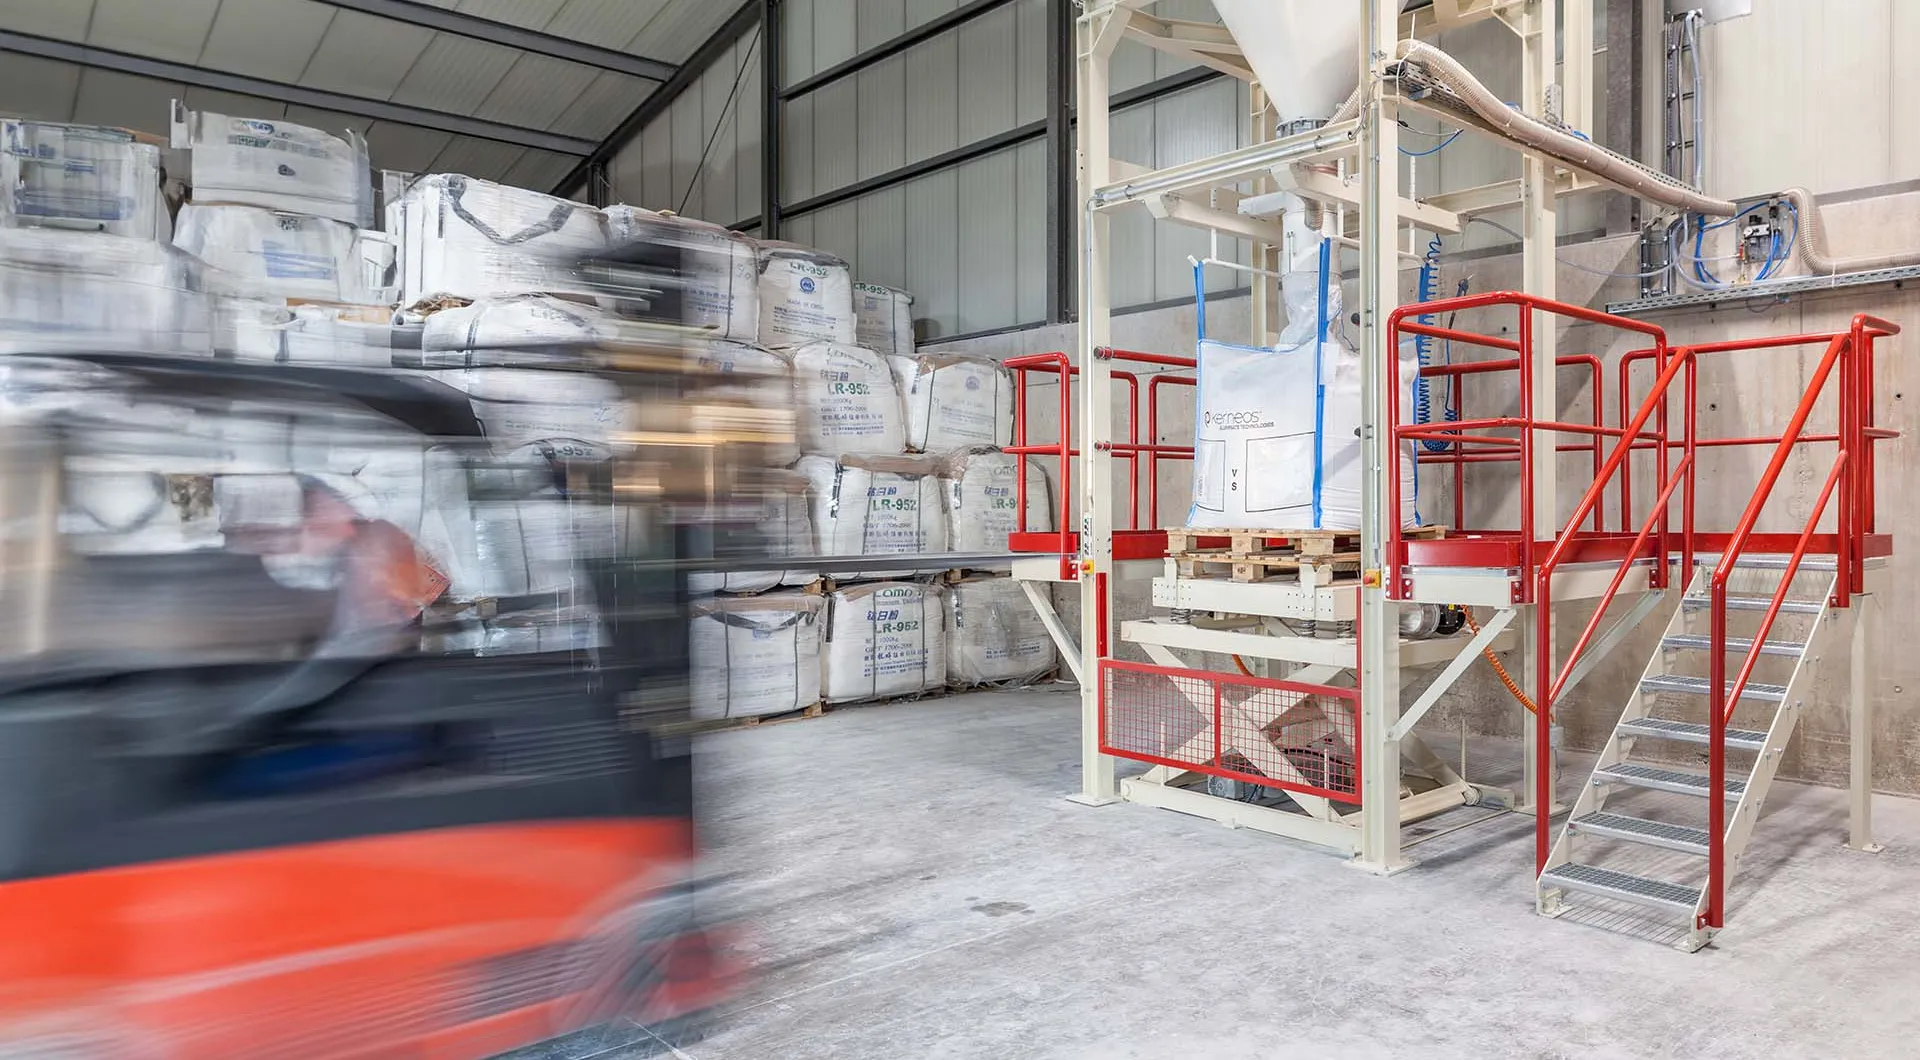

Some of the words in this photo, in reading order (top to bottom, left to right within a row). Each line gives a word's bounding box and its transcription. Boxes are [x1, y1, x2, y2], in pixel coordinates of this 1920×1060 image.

[827, 382, 871, 395] LR-952
[1231, 468, 1238, 478] V
[1231, 481, 1238, 492] S
[873, 498, 917, 511] LR-952
